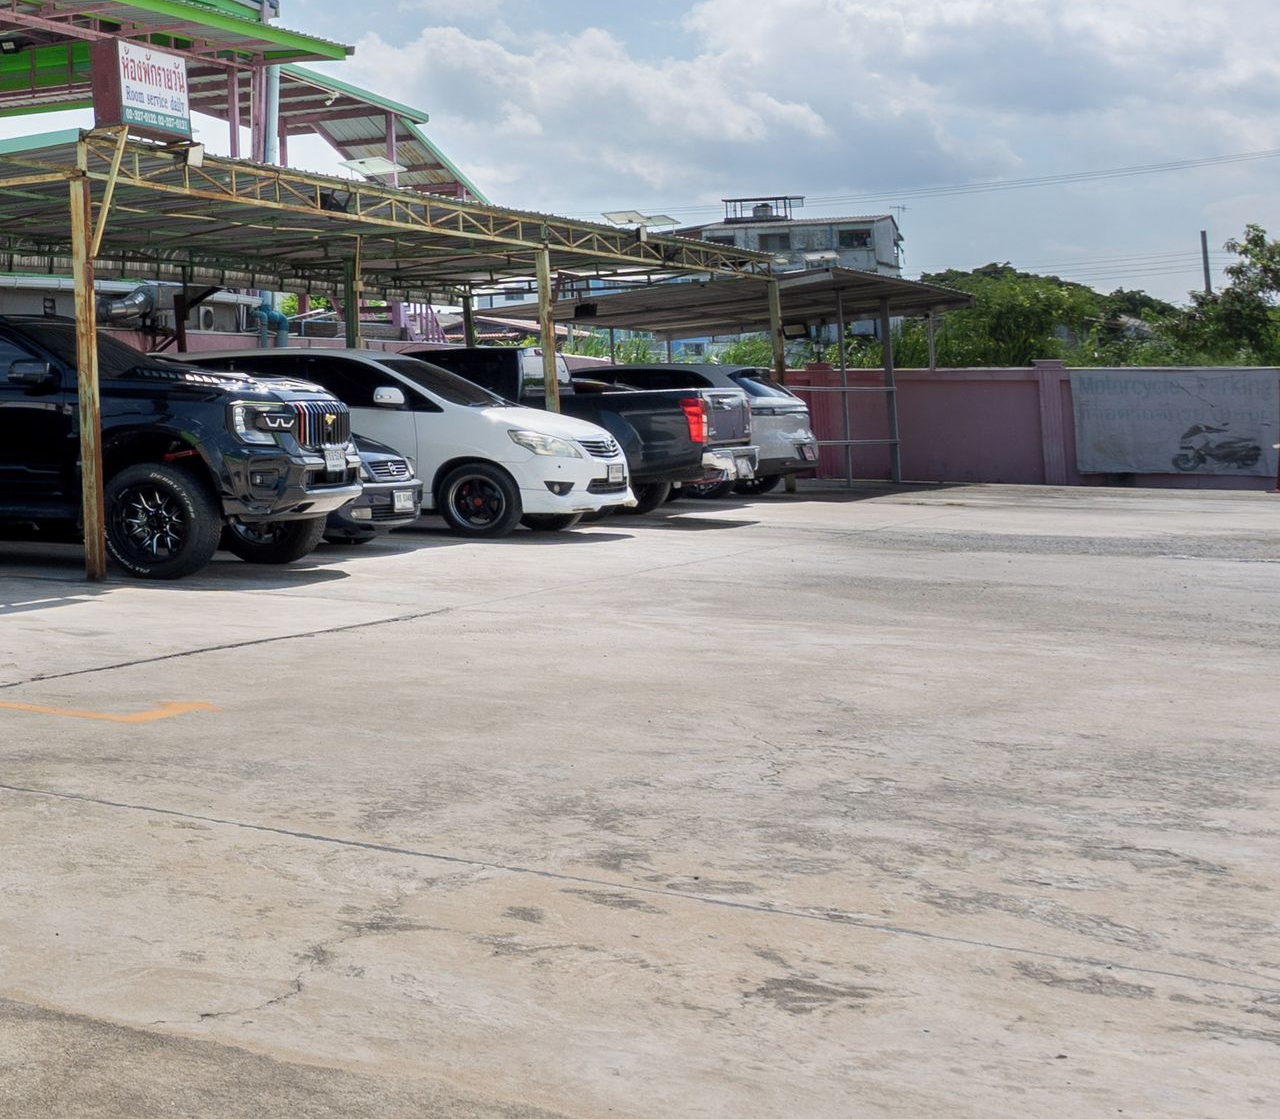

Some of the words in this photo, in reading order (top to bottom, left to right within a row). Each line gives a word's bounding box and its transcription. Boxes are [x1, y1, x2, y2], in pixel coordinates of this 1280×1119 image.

[121, 46, 185, 94] ห้องพักรายวัน
[125, 85, 145, 103] Room
[147, 93, 168, 109] service
[171, 95, 185, 117] daily
